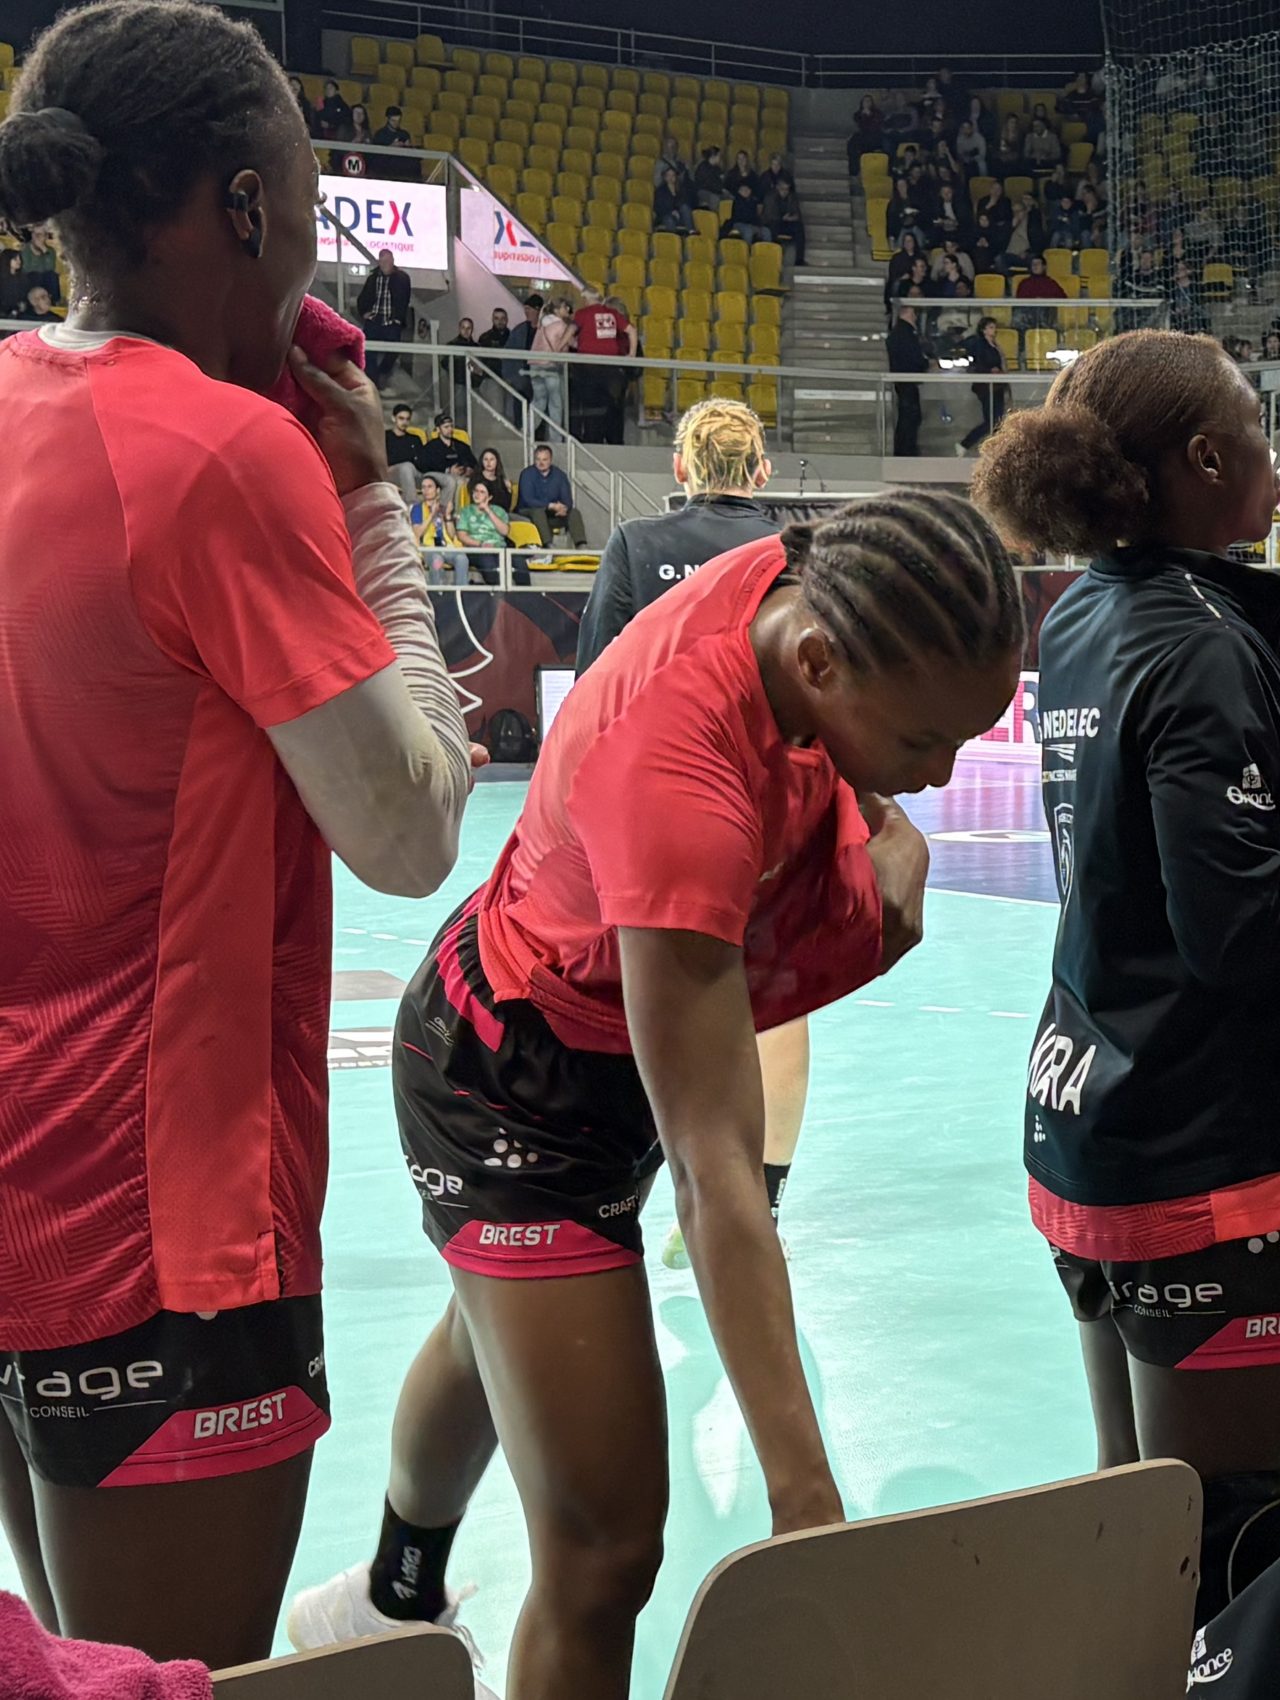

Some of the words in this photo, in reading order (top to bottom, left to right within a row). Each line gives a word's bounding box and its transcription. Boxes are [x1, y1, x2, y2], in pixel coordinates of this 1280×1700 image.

[1043, 708, 1101, 739] NEDELEC
[479, 1224, 560, 1246] BREST
[29, 1405, 90, 1418] CONSEIL
[194, 1393, 286, 1439] BREST
